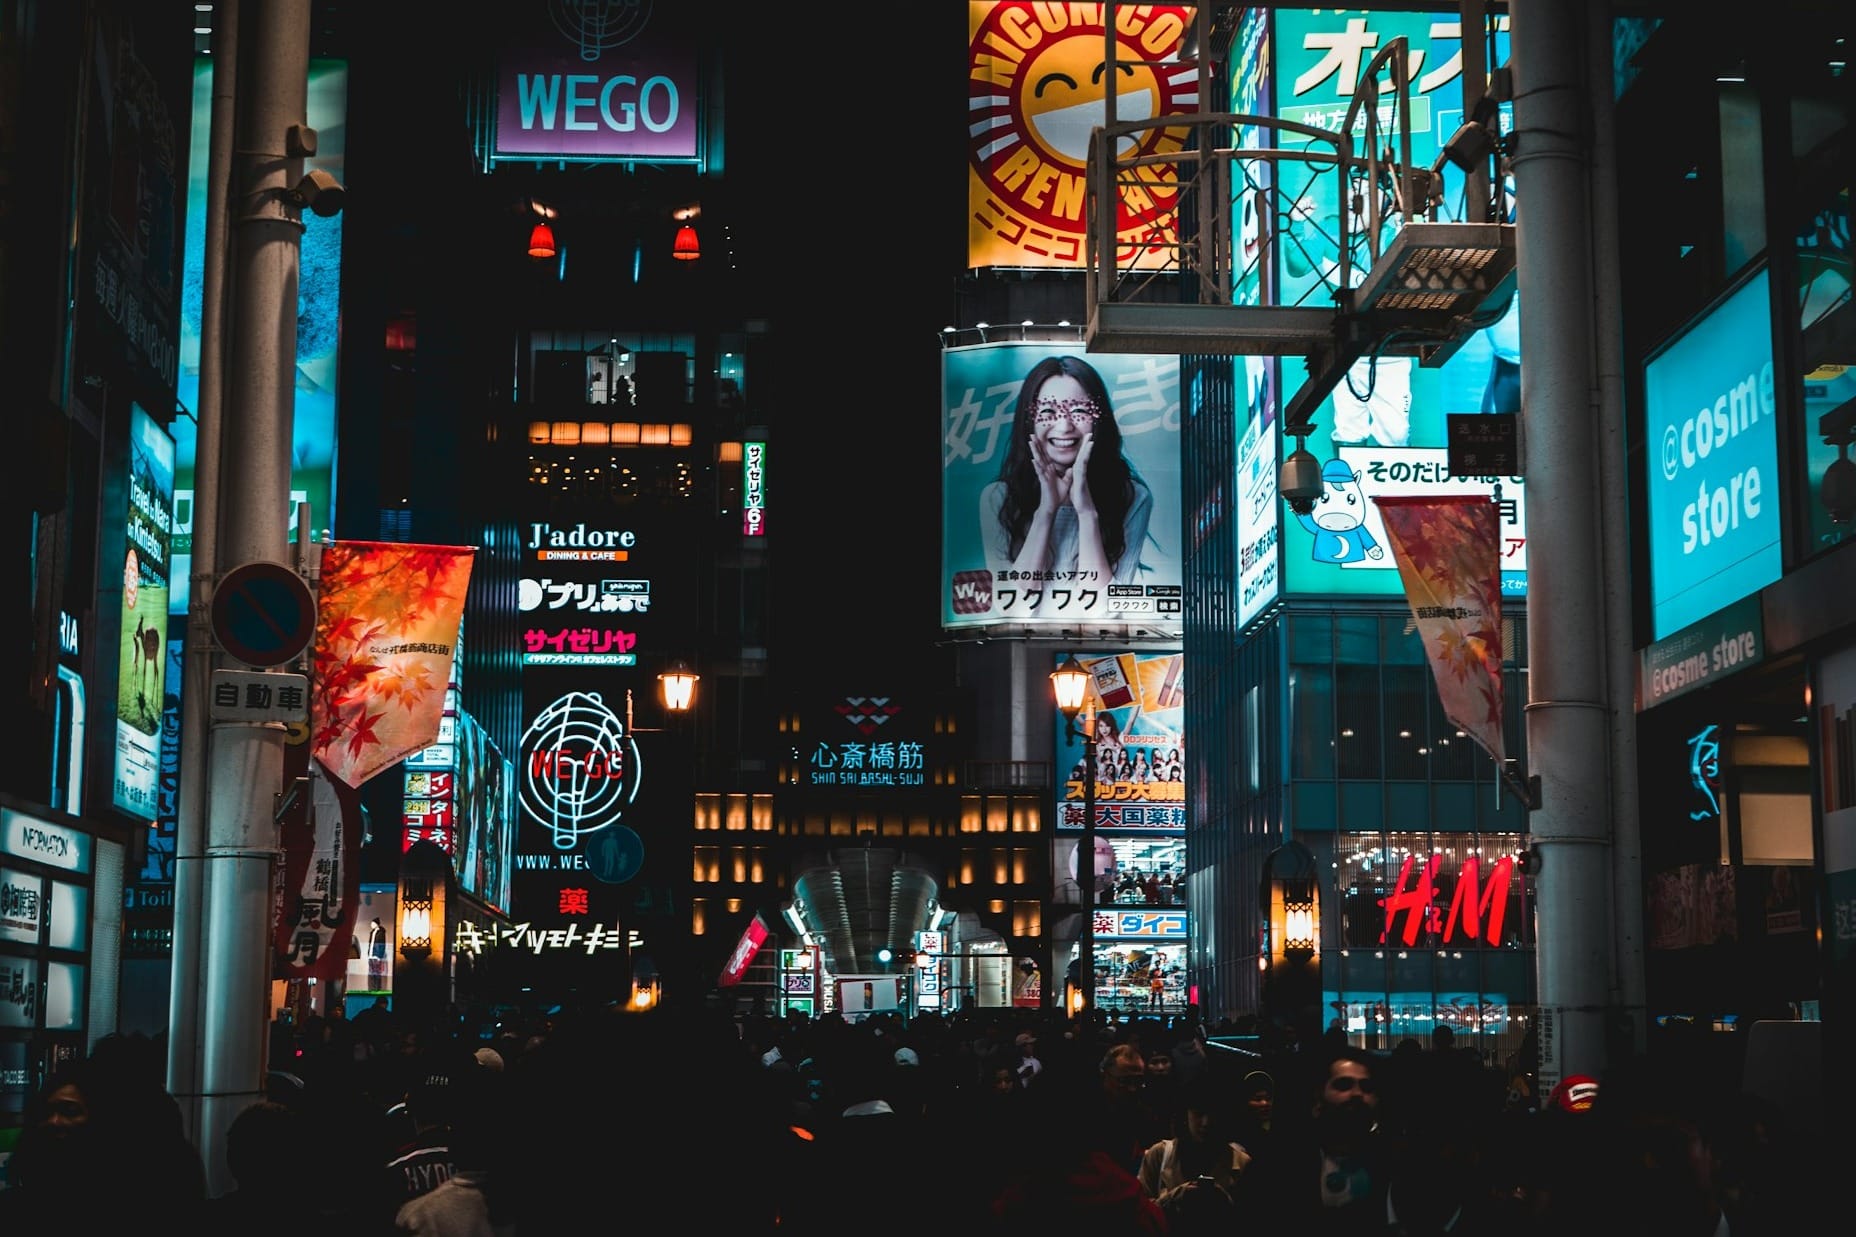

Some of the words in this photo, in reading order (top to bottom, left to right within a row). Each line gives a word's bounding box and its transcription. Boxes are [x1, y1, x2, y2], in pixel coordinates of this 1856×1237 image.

[517, 72, 680, 133] WEGO
[1661, 360, 1776, 481] @cosme
[748, 446, 761, 505] サイゼリヤ
[130, 473, 151, 517] Travel
[154, 498, 170, 534] Nara
[1682, 465, 1762, 556] store
[747, 508, 761, 535] 6F
[528, 523, 636, 549] J'adore
[546, 551, 580, 561] DINING
[581, 551, 588, 561] &
[590, 551, 616, 561] CAFE
[997, 570, 1099, 581] 運命の出会いアプリ
[997, 589, 1099, 611] ワクワク
[1112, 600, 1150, 610] ワクワク
[524, 628, 637, 653] サイゼリヤ
[1652, 650, 1709, 698] @cosme
[1712, 630, 1756, 673] store
[214, 682, 304, 713] 自動車
[532, 749, 623, 779] WEGO
[810, 741, 925, 770] 心斎橋筋
[811, 771, 836, 785] SHIN
[839, 771, 857, 785] SAI
[1064, 780, 1186, 801] スッフ大募集
[406, 814, 422, 848] コミ
[516, 854, 591, 870] WWW.WE
[559, 887, 589, 915] 薬
[1377, 854, 1514, 948] H&M
[1093, 912, 1115, 934] 薬
